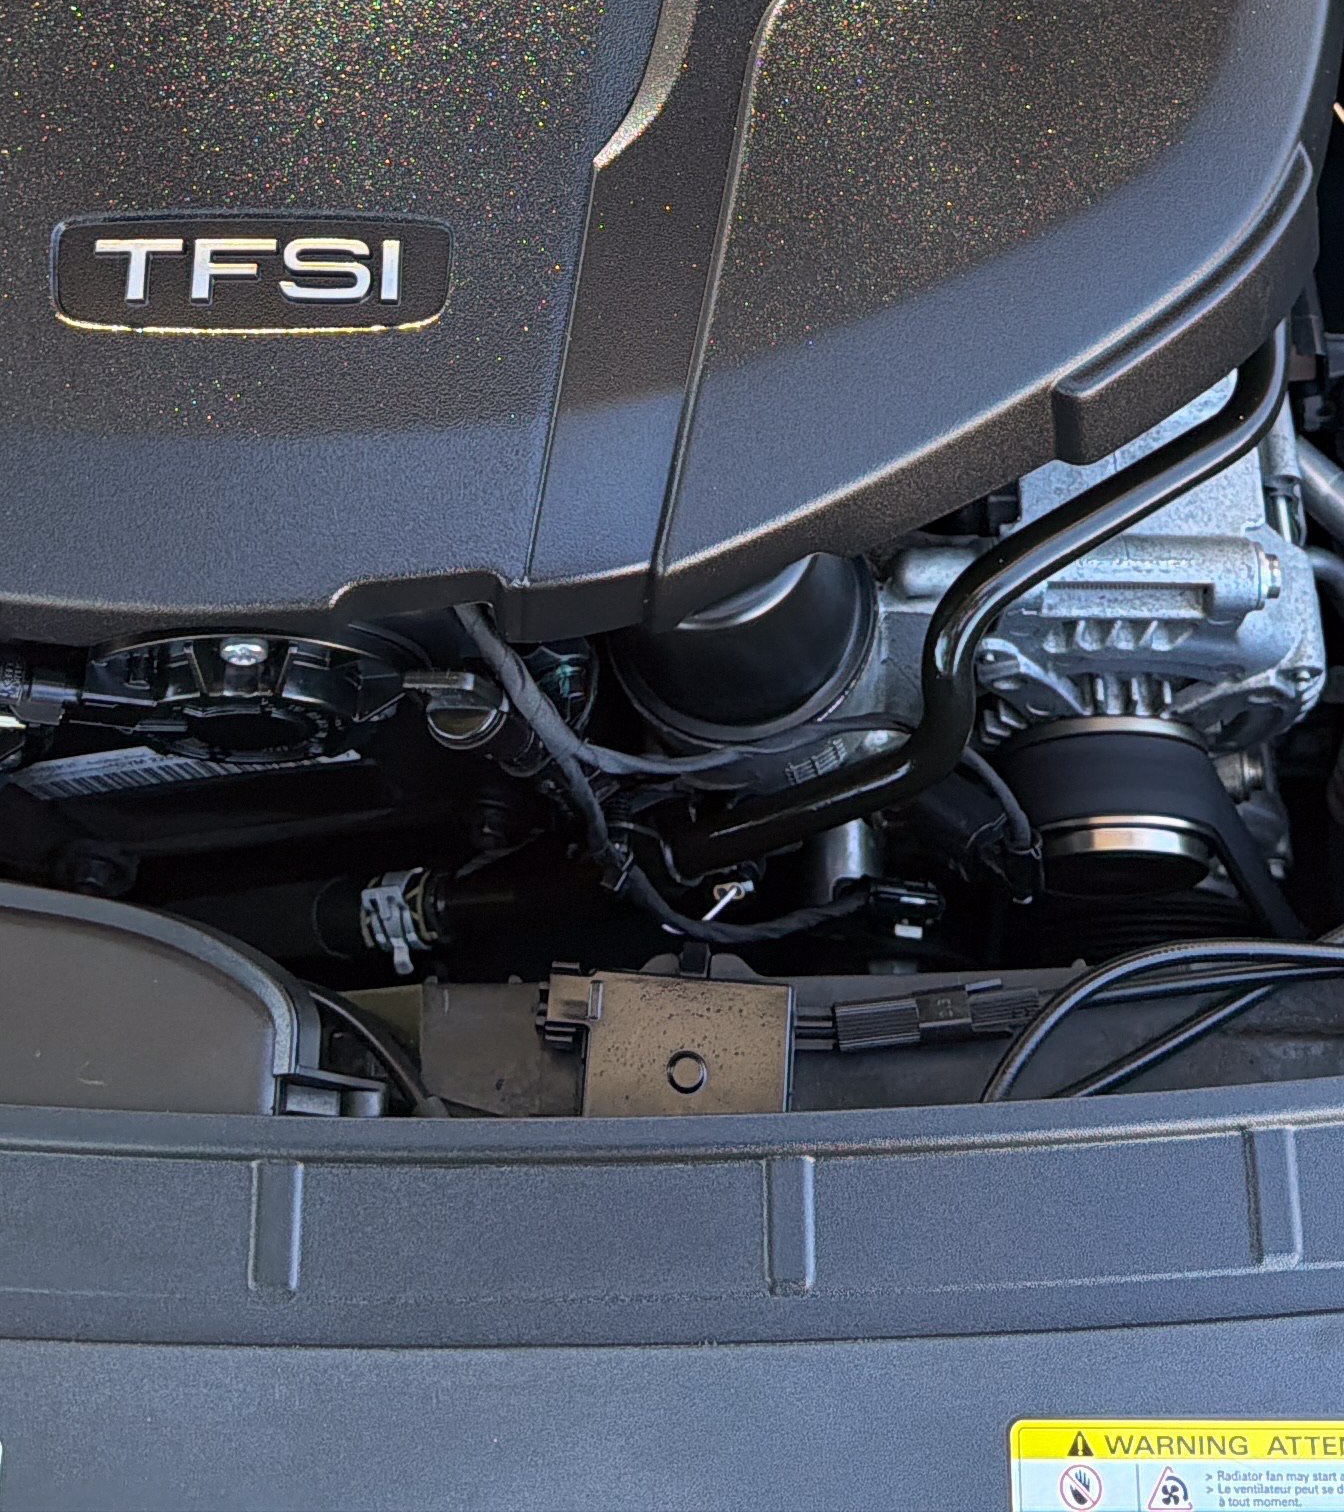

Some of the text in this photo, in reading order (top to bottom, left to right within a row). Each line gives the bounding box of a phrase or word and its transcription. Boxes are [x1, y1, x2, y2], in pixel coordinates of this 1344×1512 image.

[94, 237, 402, 304] TFSI
[1104, 1434, 1248, 1456] WARNING
[1217, 1470, 1263, 1482] Radiator
[1266, 1470, 1284, 1482] fan
[1286, 1471, 1310, 1484] may
[1312, 1471, 1337, 1482] start
[1218, 1484, 1231, 1495] Le
[1233, 1484, 1292, 1495] ventilateur
[1294, 1484, 1319, 1497] peut
[1321, 1485, 1334, 1495] se
[1228, 1497, 1251, 1507] tout
[1252, 1497, 1303, 1508] moment.
